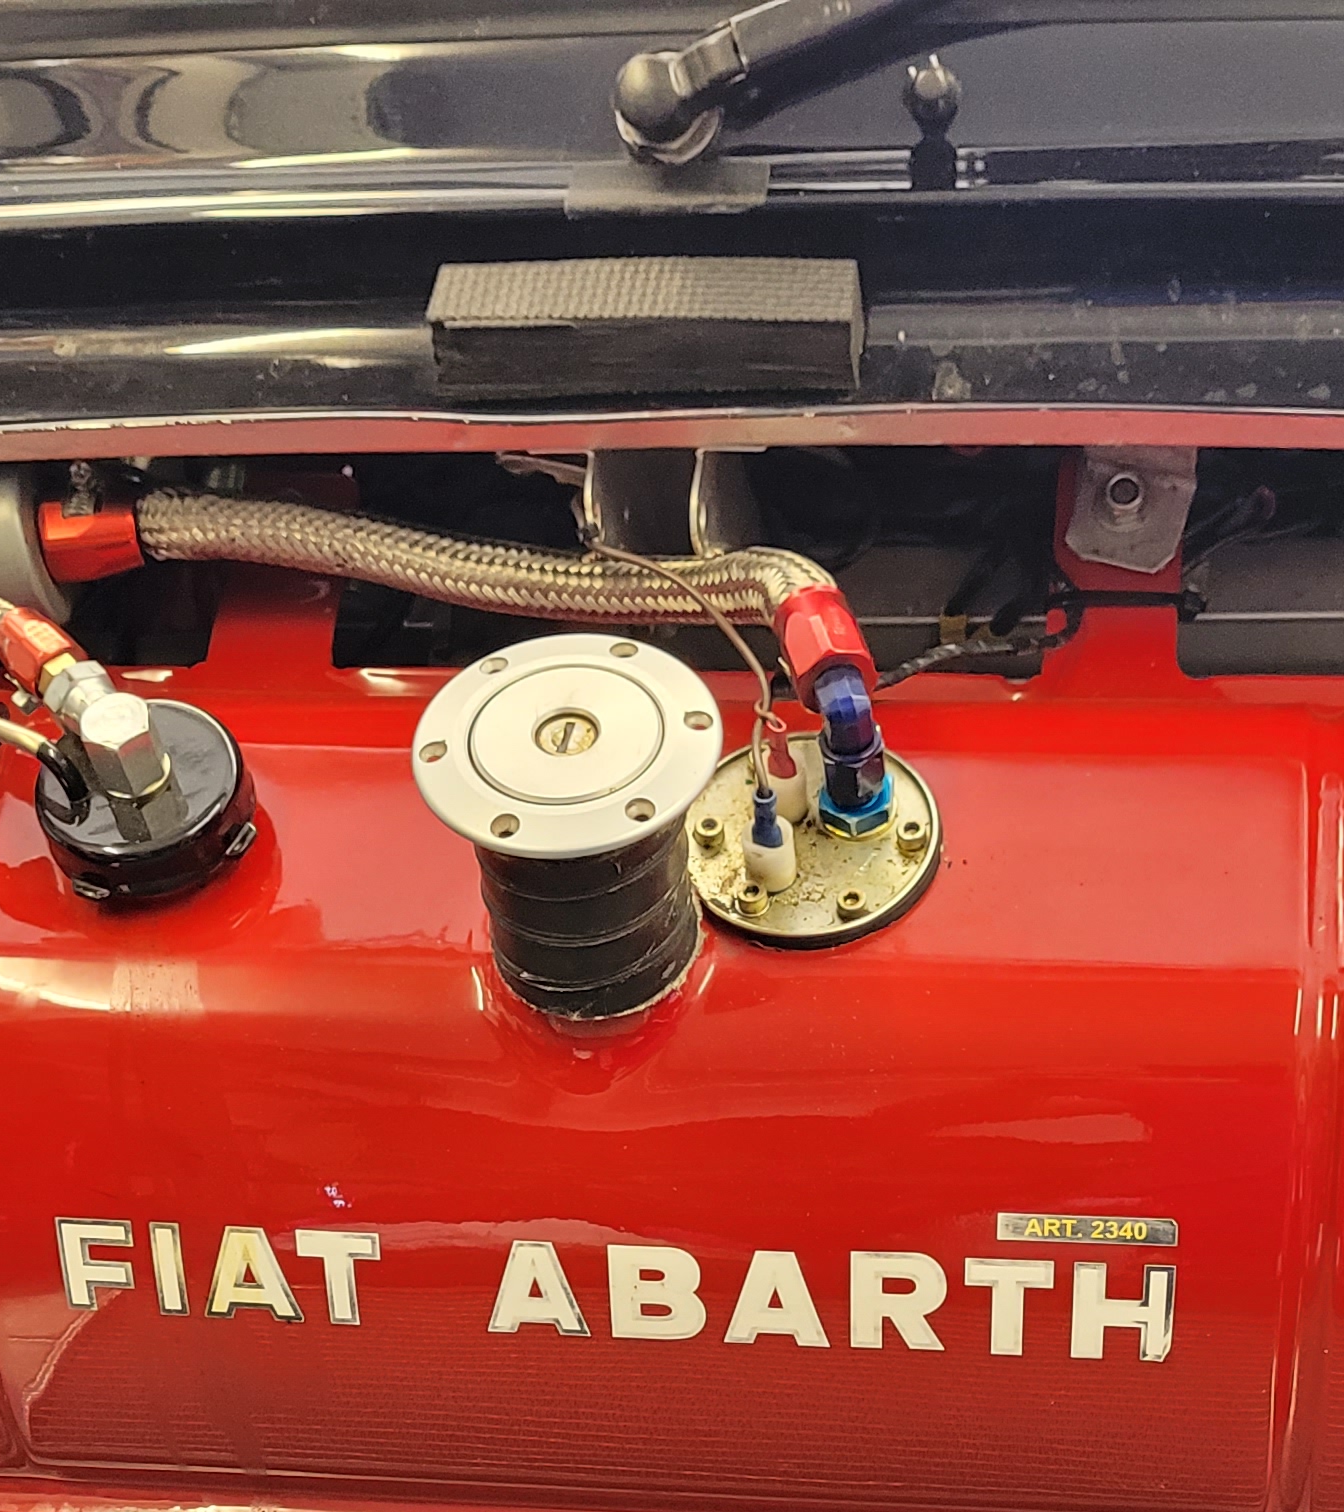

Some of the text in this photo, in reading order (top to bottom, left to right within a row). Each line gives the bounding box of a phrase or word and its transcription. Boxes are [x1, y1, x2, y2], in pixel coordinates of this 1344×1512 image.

[1023, 1218, 1148, 1240] ART. 2340
[54, 1216, 1177, 1362] FIAT ABARTH
